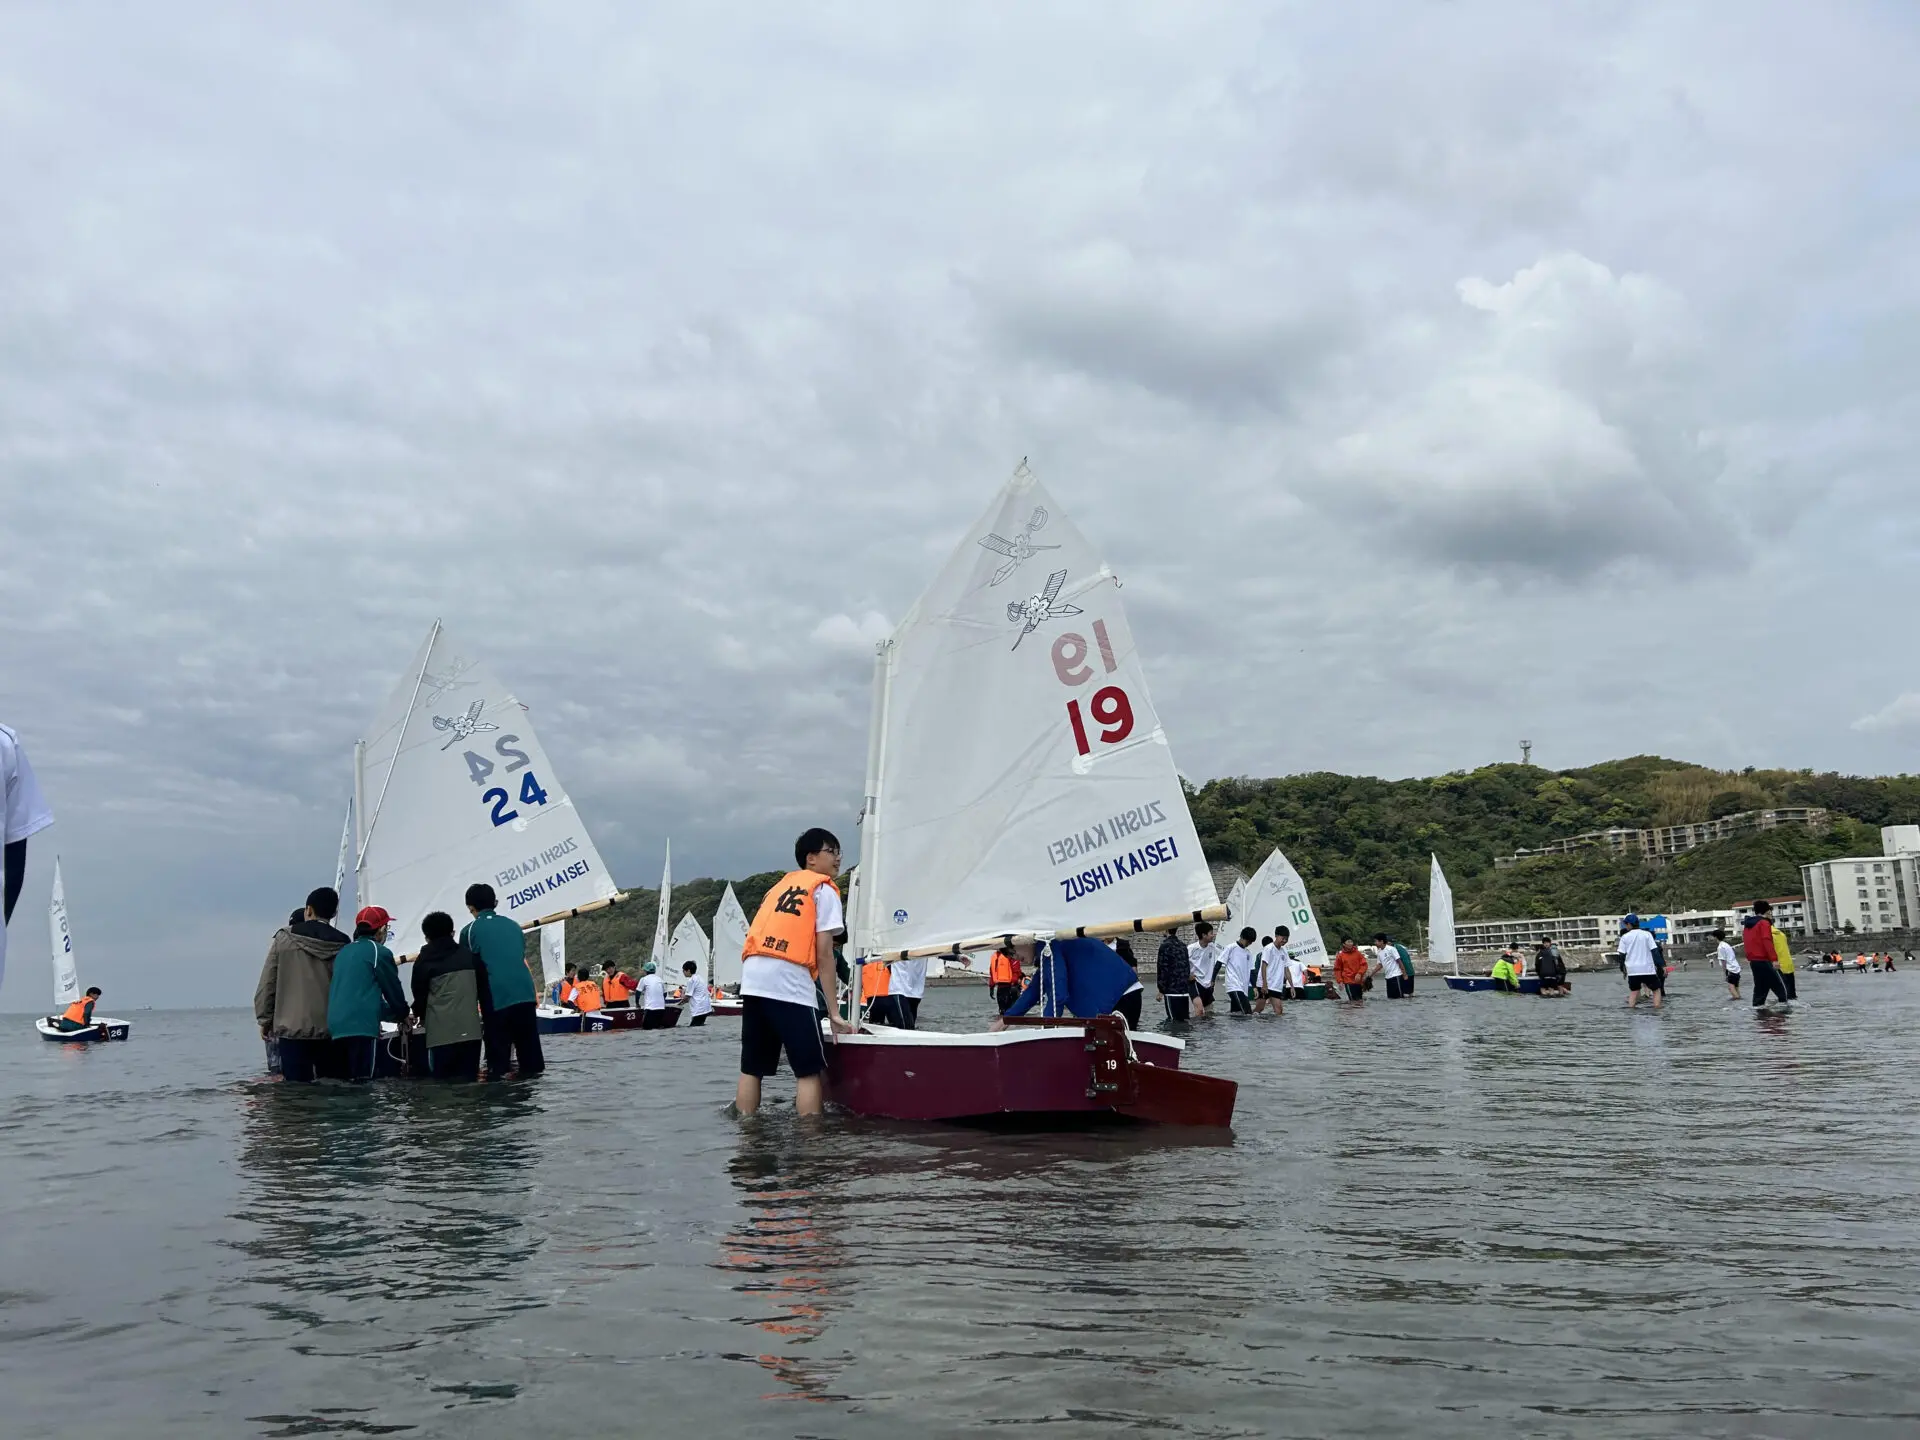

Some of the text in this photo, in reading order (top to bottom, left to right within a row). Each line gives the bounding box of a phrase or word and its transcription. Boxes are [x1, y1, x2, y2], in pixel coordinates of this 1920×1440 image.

[1066, 685, 1134, 757] 19
[482, 770, 548, 828] 24
[1060, 836, 1179, 902] ZUSHI KAISEI
[506, 859, 590, 910] ZUSHI KAISEI
[775, 886, 808, 916] 佐
[1291, 908, 1310, 925] 10
[762, 935, 789, 953] 忠直
[626, 1012, 636, 1020] 23
[110, 1028, 122, 1038] 26
[591, 1022, 604, 1030] 25
[1106, 1059, 1117, 1070] 19
